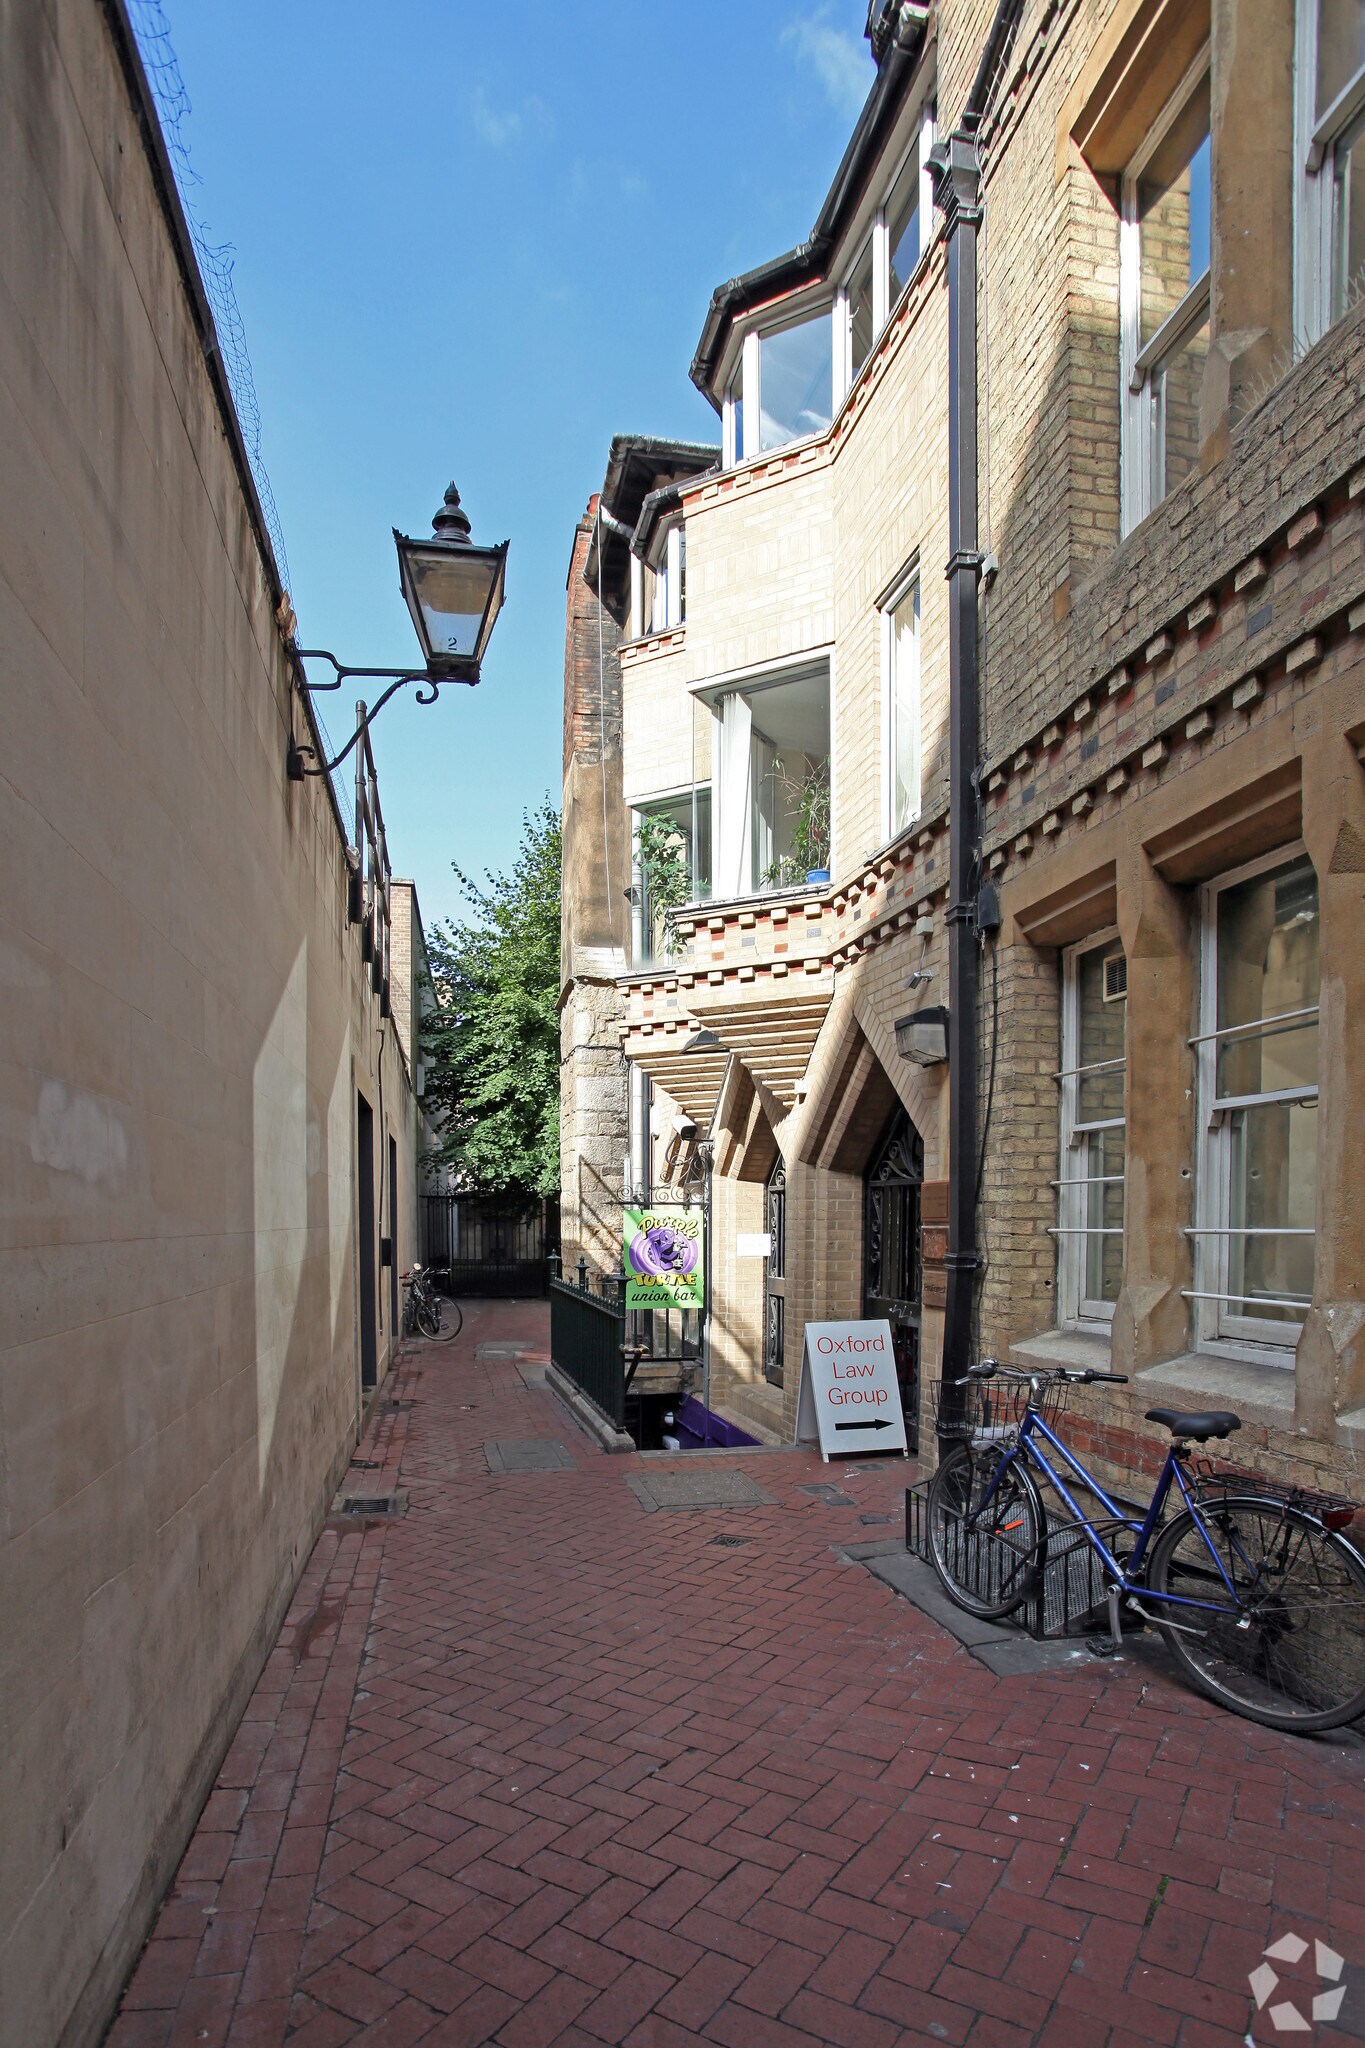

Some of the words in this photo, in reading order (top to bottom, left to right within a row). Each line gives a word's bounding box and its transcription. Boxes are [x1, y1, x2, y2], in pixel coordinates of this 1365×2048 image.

[448, 637, 457, 650] 2
[637, 1215, 699, 1240] Purple
[632, 1273, 697, 1286] TURTLE
[632, 1290, 669, 1301] union
[673, 1287, 697, 1301] bar
[817, 1335, 885, 1354] Oxford
[832, 1362, 875, 1379] Law
[828, 1387, 888, 1406] Group
